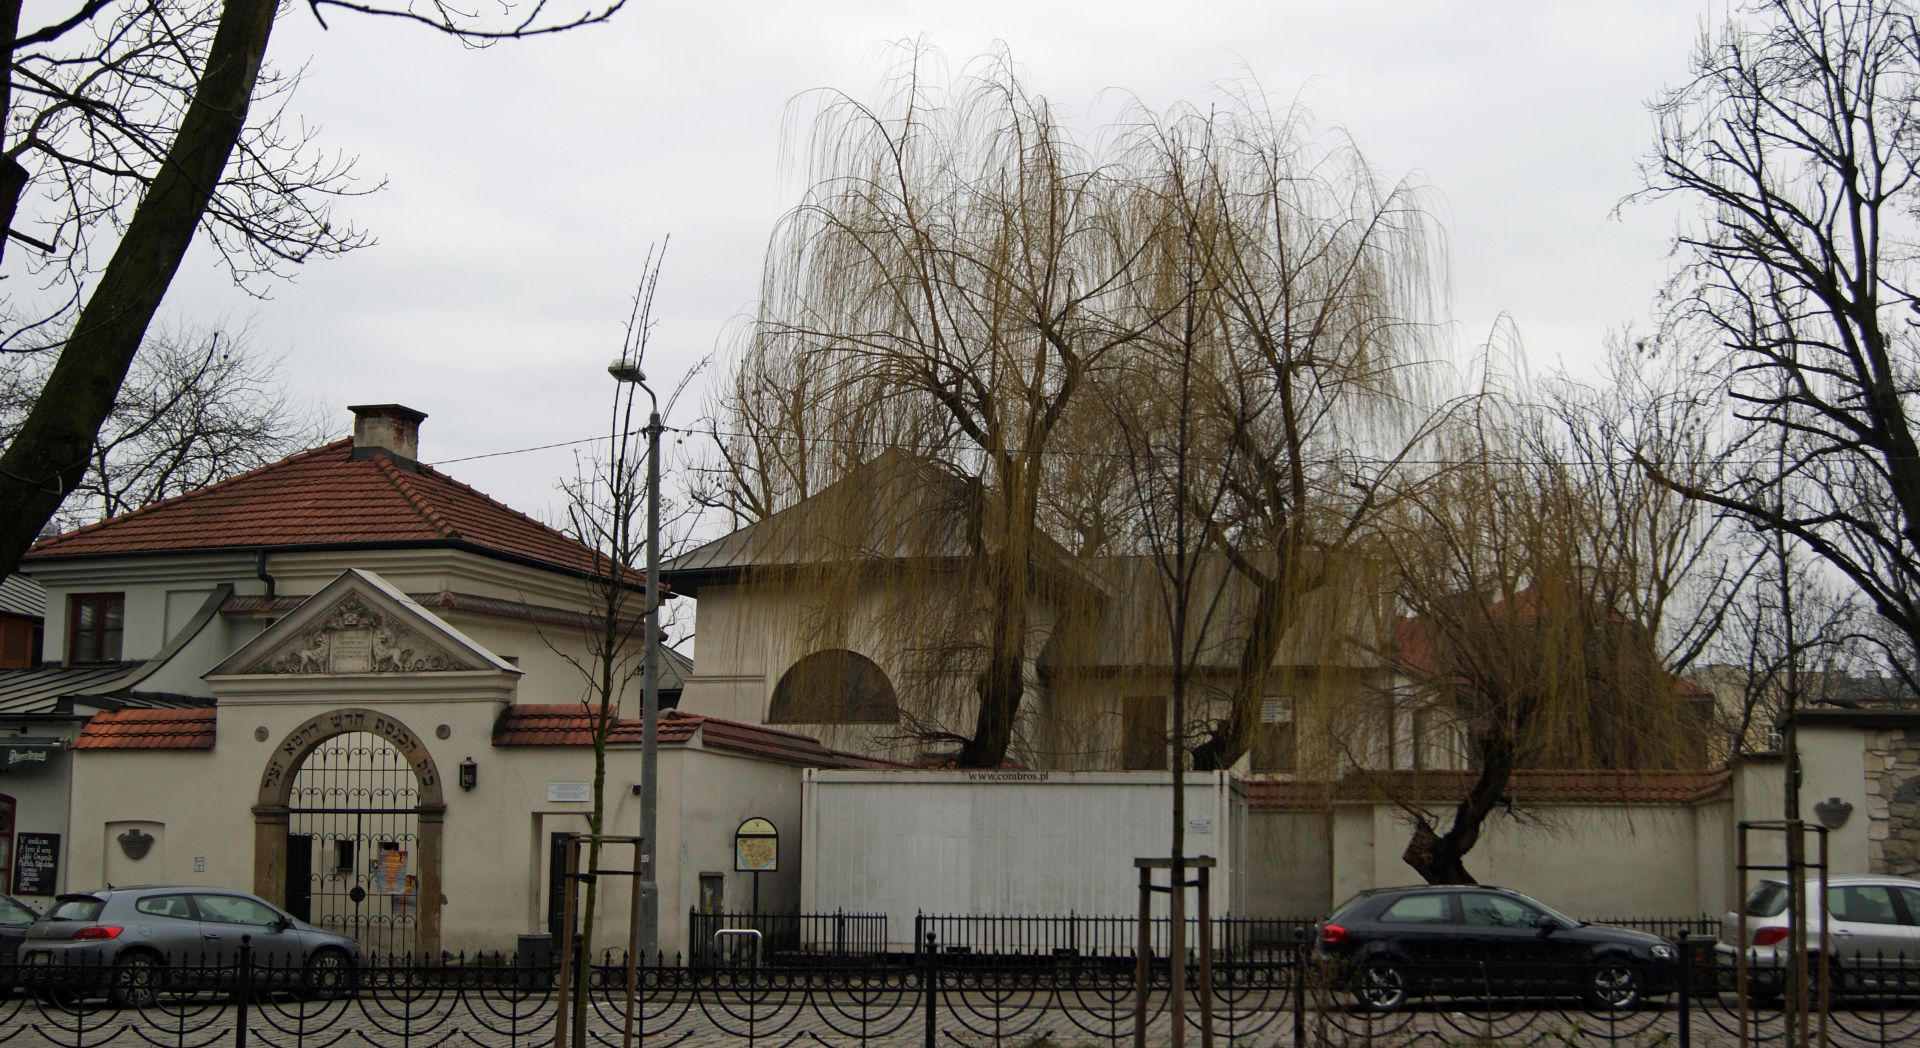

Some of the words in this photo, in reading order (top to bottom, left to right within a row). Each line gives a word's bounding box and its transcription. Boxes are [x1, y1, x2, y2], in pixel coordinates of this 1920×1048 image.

[330, 713, 365, 729] חדש
[374, 718, 417, 753] הכנסת
[416, 759, 435, 786] בית
[969, 771, 1049, 782] www.combros.pl
